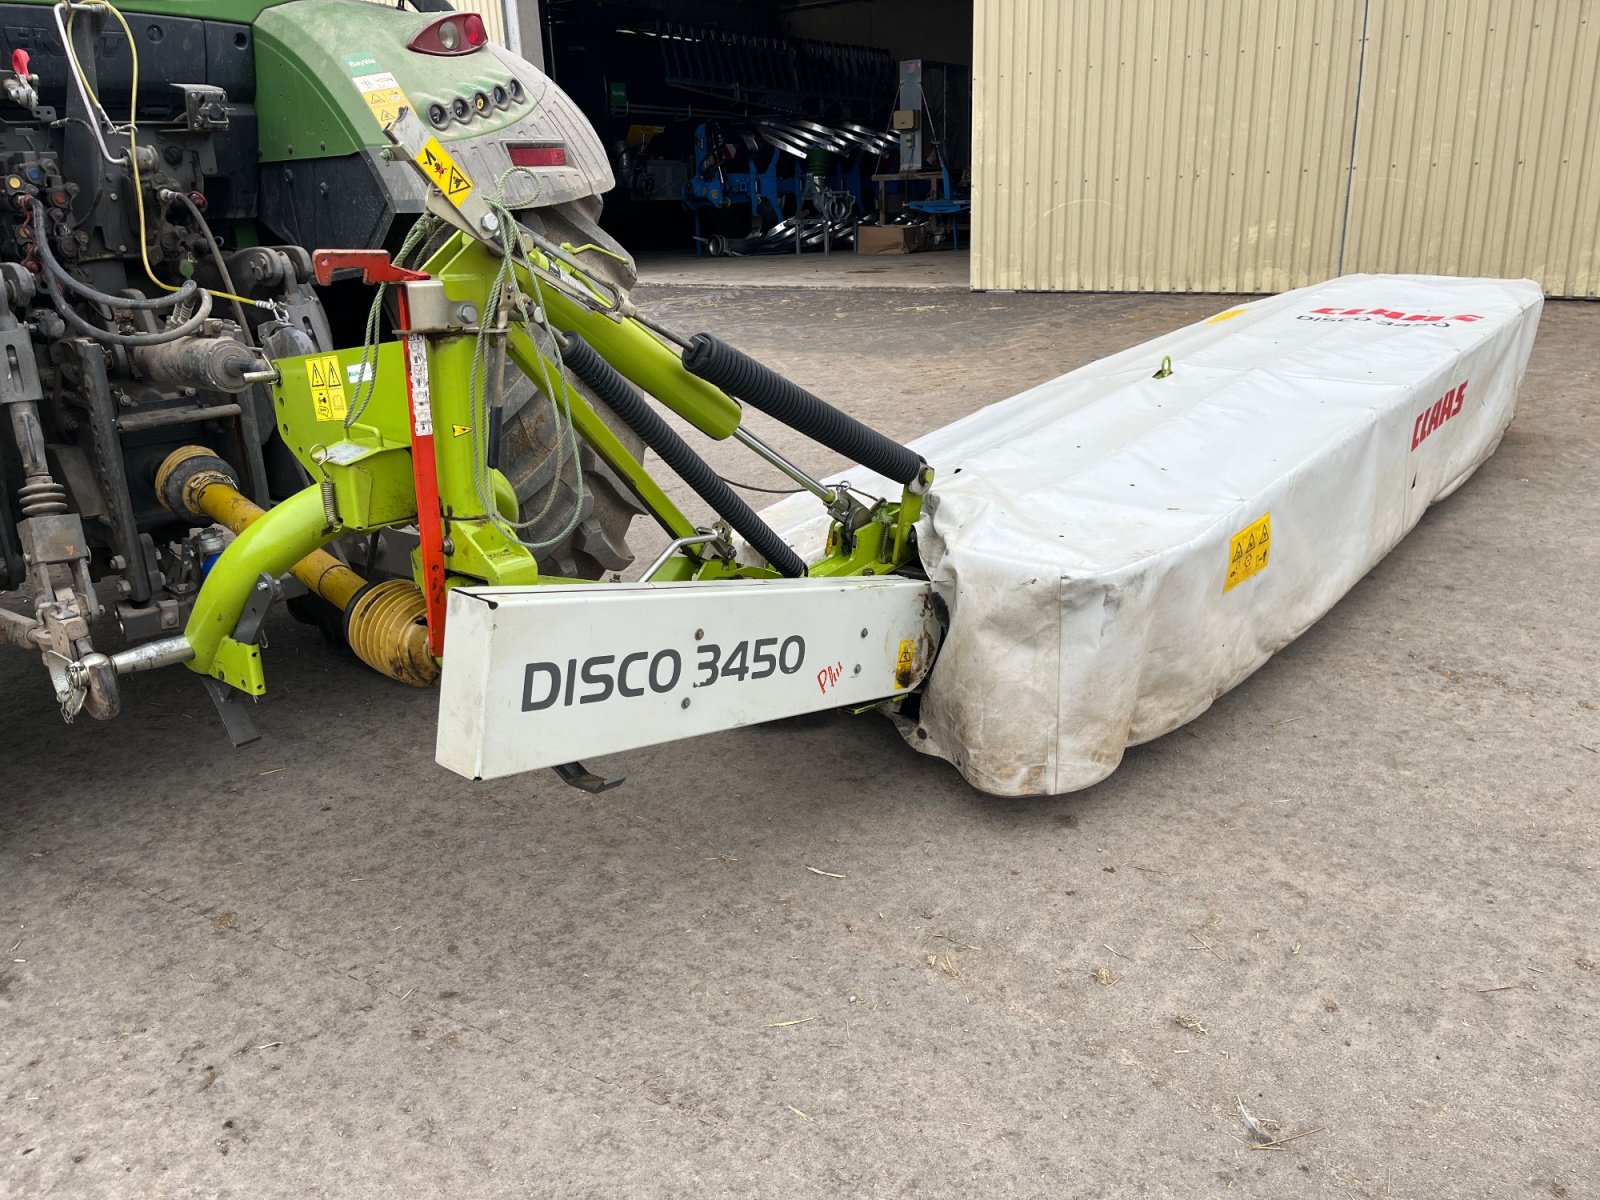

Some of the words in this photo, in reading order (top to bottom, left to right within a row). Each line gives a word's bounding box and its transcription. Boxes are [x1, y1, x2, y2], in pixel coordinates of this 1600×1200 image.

[1296, 315, 1371, 323] DISCO
[1410, 379, 1469, 453] CLAAS
[521, 648, 682, 712] DISCO
[692, 634, 806, 689] 3450
